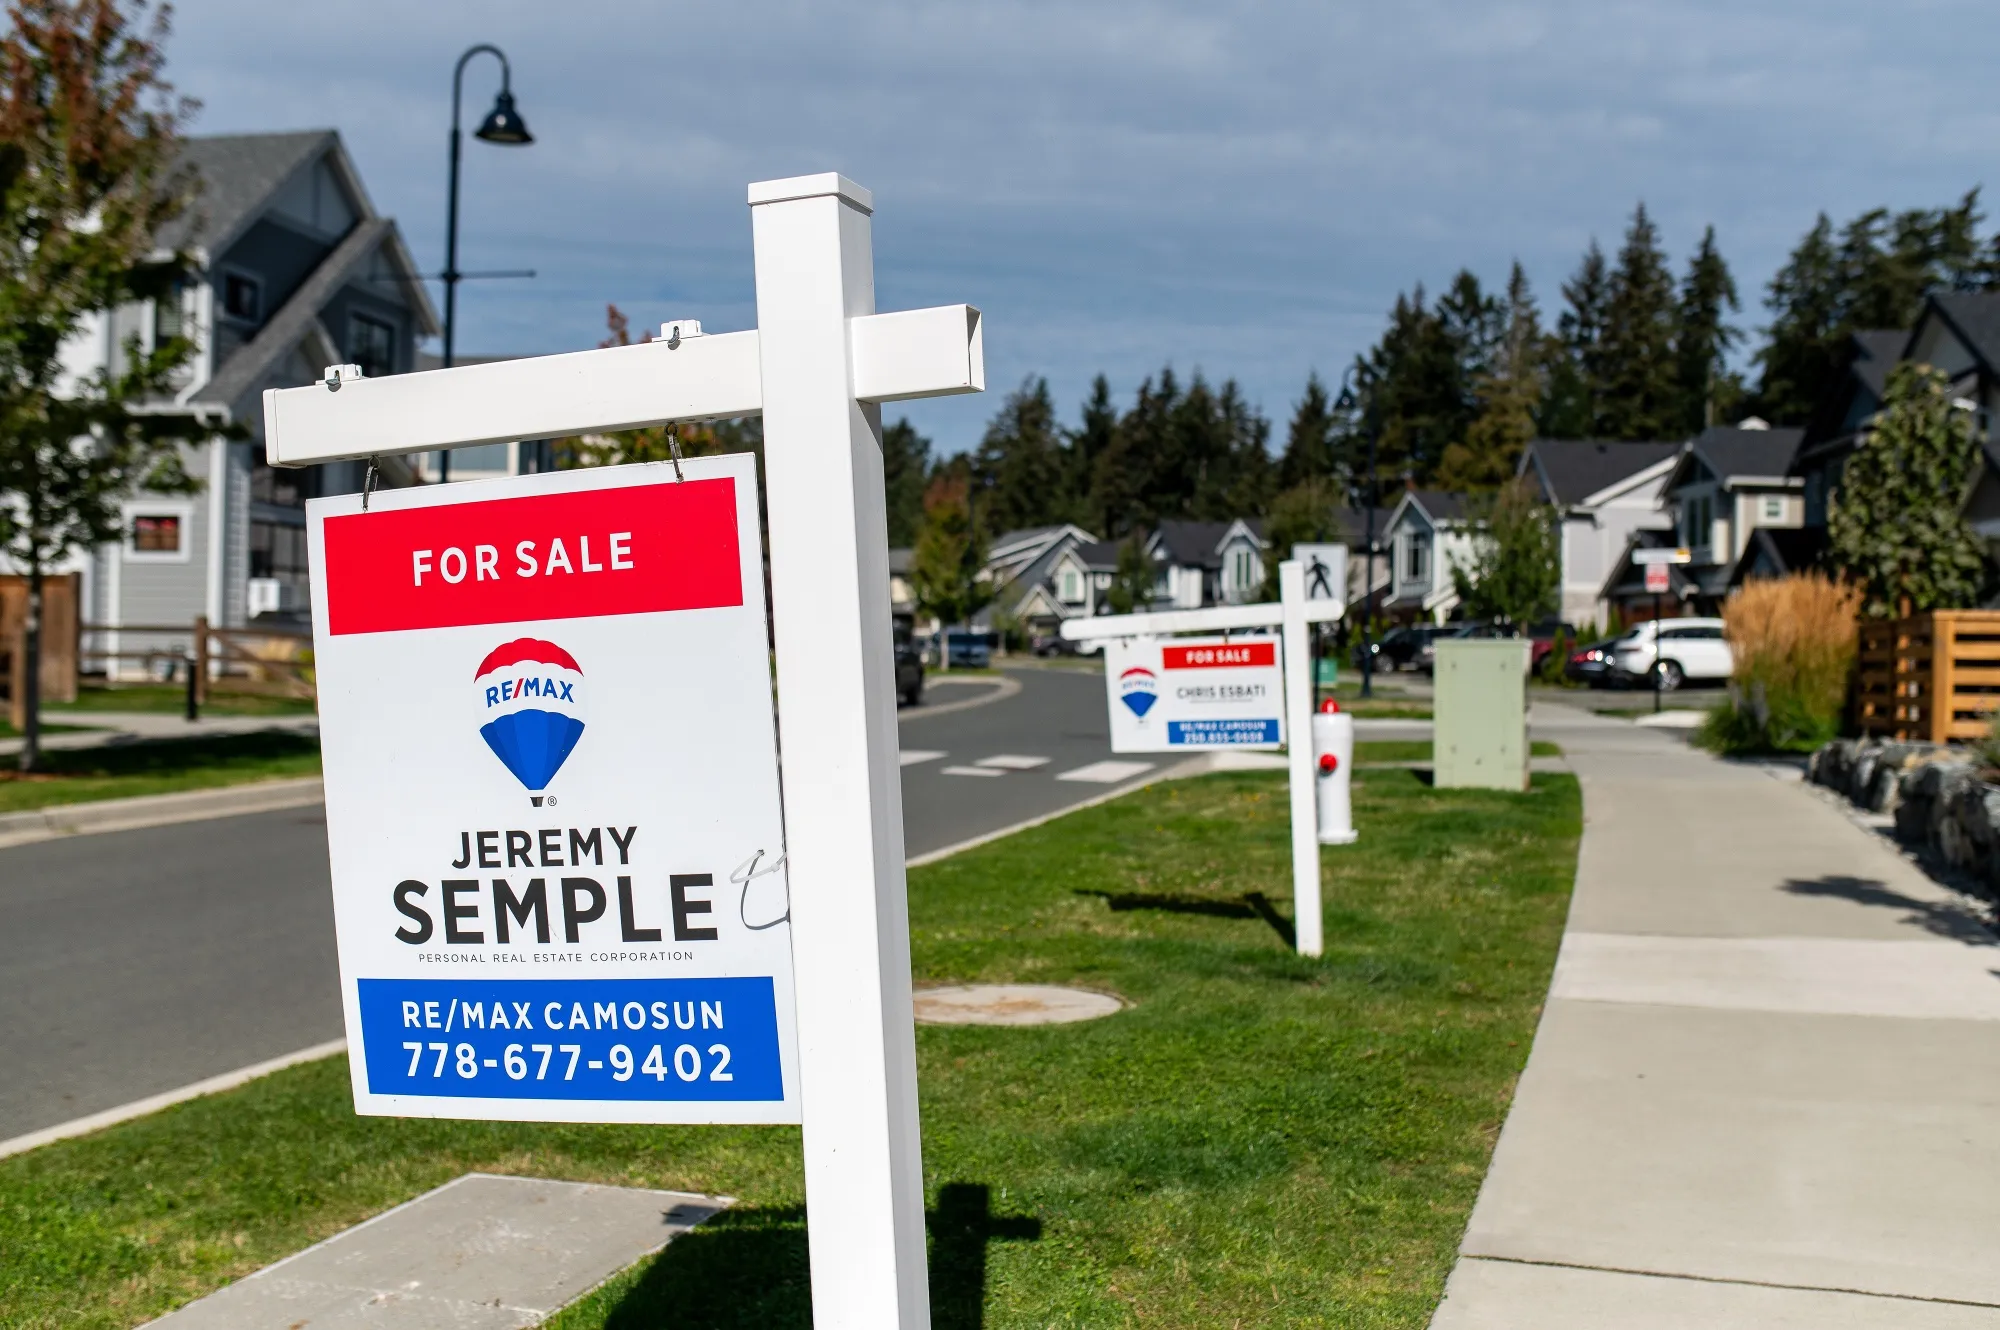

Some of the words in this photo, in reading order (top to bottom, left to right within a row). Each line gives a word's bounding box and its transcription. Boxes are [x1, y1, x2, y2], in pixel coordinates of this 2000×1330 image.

[412, 545, 501, 587] FOR
[516, 532, 635, 579] SALE
[1186, 650, 1214, 664] FOR
[1216, 647, 1251, 663] SALE
[485, 677, 575, 709] RE/MAX
[1177, 685, 1216, 699] CHRIS
[1219, 683, 1266, 698] ESBATI
[451, 826, 638, 870] JEREMY
[392, 872, 719, 945] SEMPLE
[418, 953, 486, 963] PERSONAL
[493, 953, 527, 963] REAL
[533, 953, 584, 963] ESTATE
[590, 951, 694, 963] CORPORATION
[402, 999, 534, 1033] RE/MAX
[544, 1000, 724, 1031] CAMOSUN
[402, 1041, 734, 1082] 778-677-9402
